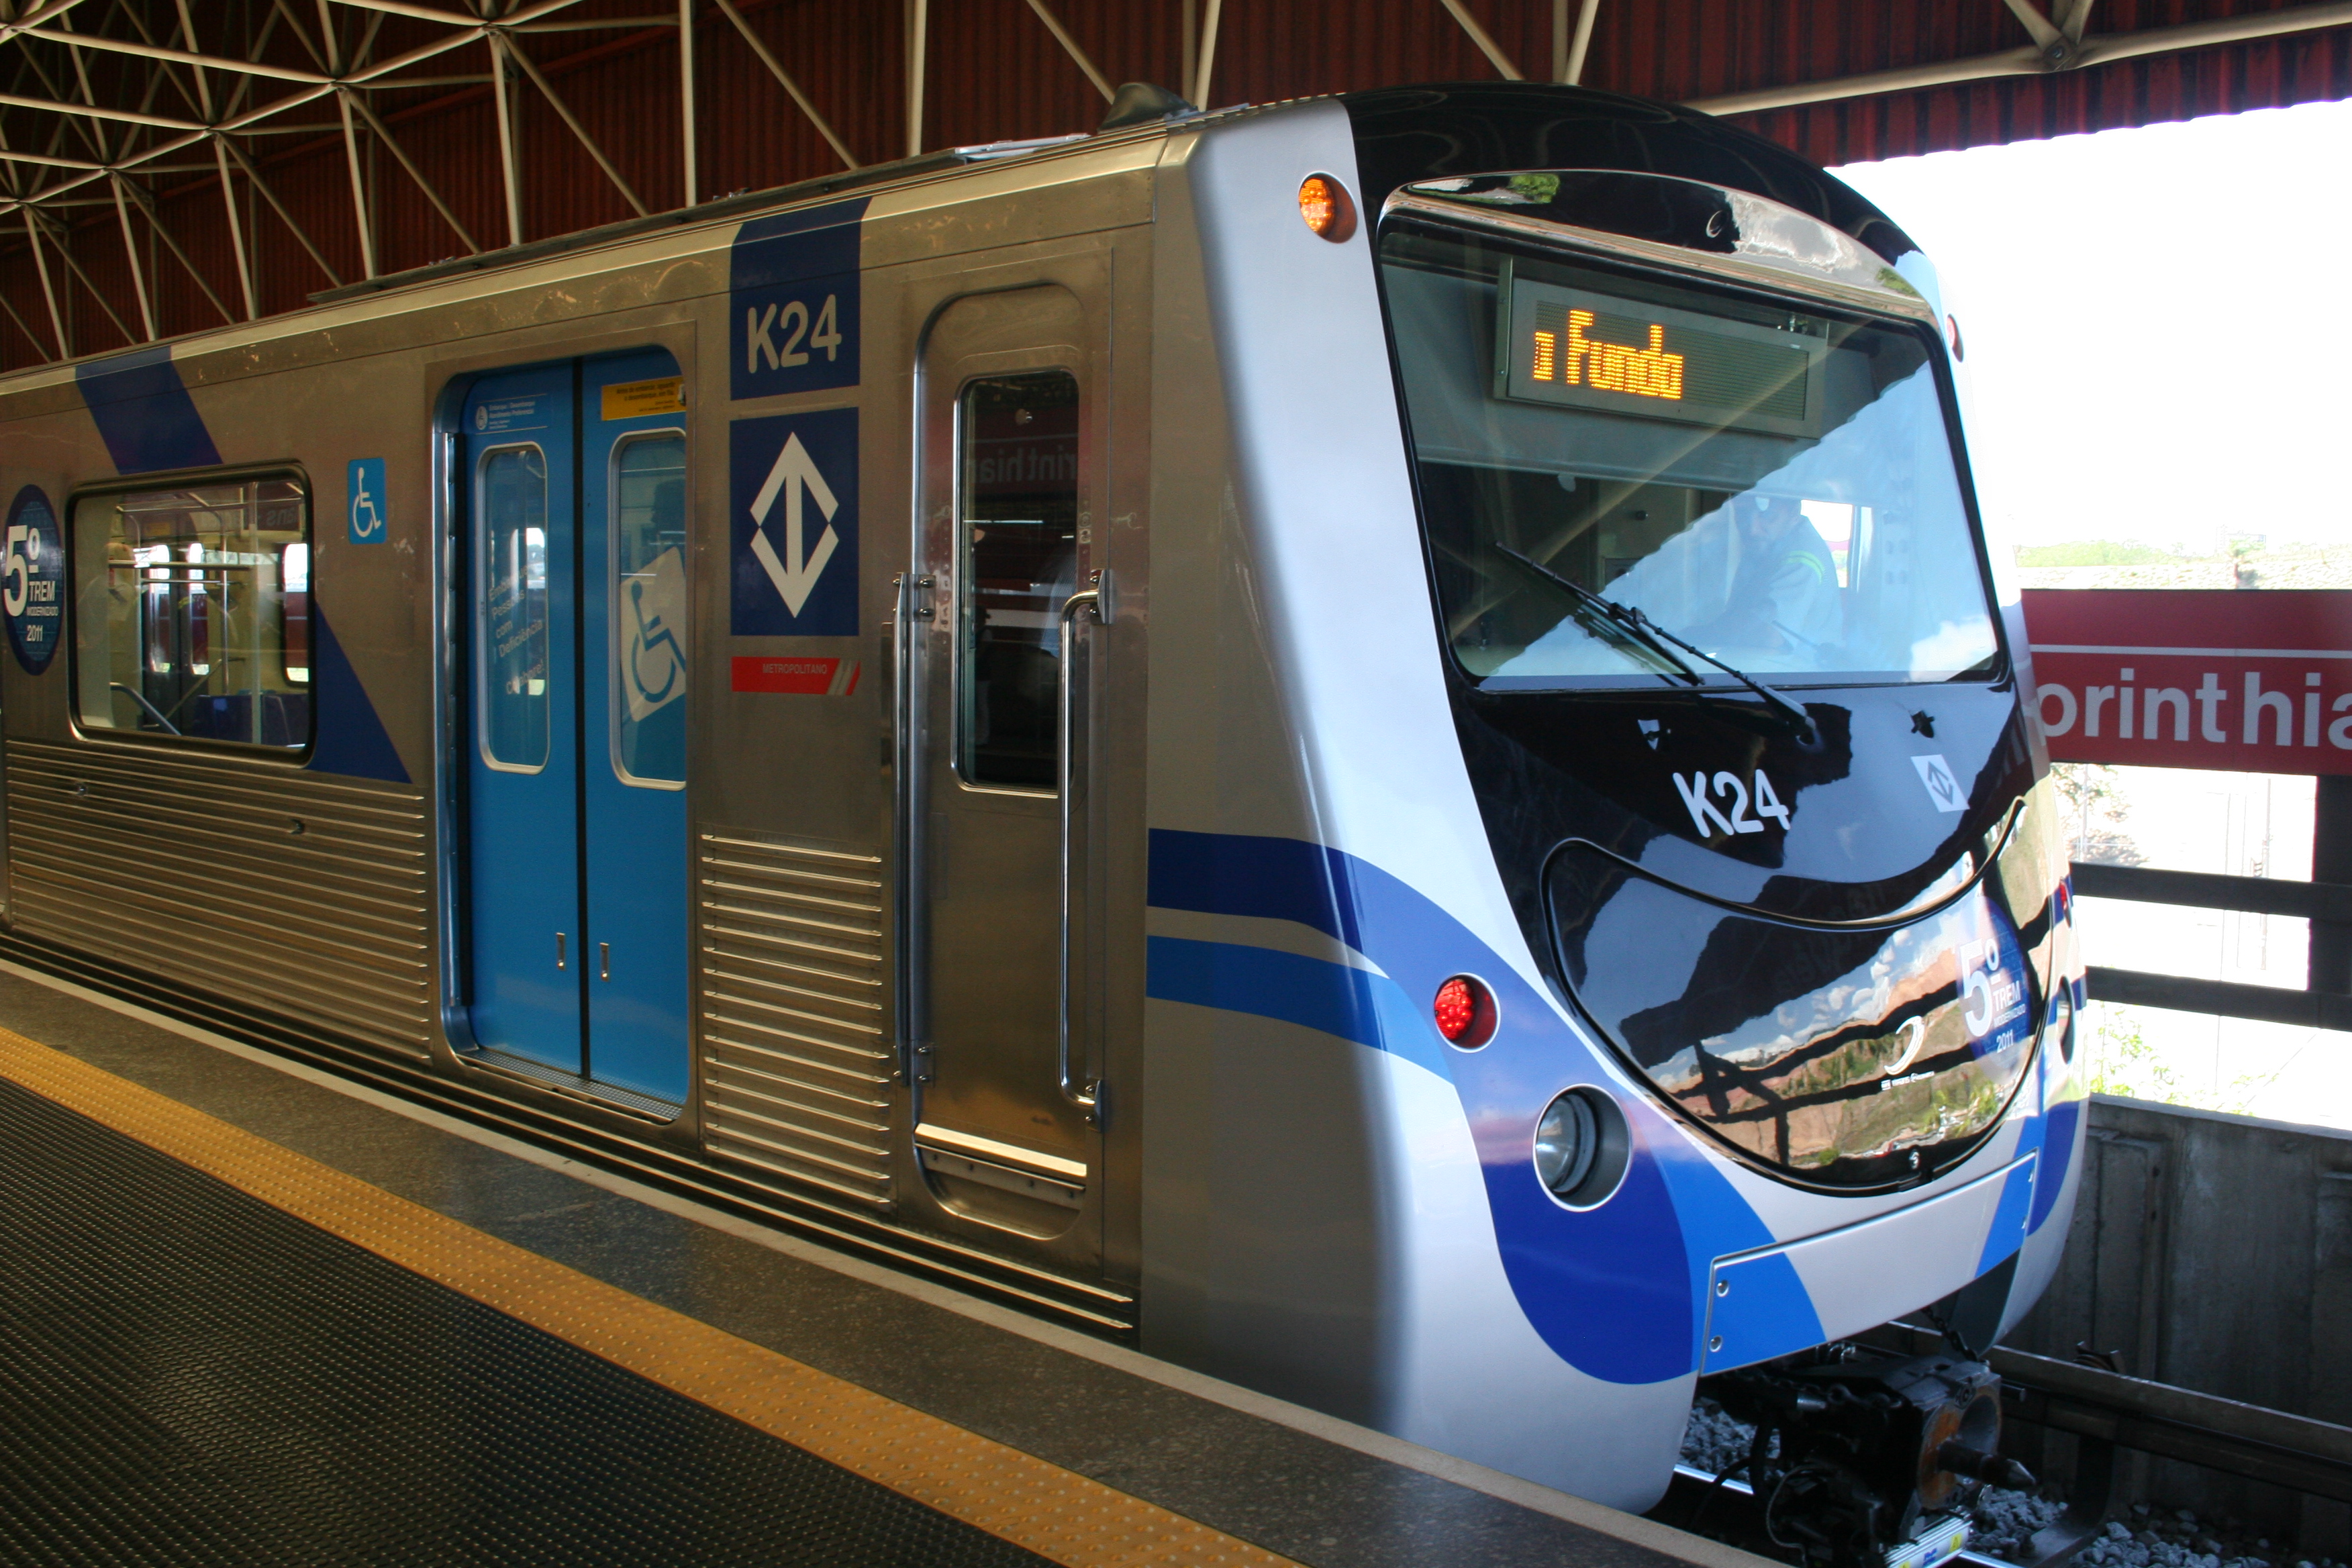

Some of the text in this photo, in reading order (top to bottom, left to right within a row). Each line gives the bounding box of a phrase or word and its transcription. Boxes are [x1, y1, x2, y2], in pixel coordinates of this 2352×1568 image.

[747, 293, 842, 374] K24
[28, 581, 56, 602] TREM
[26, 625, 43, 642] 2011
[763, 663, 828, 675] METROPOLITANO
[1672, 769, 1791, 838] K24
[1992, 979, 2022, 1012] TREM
[1996, 1028, 2014, 1054] 2011
